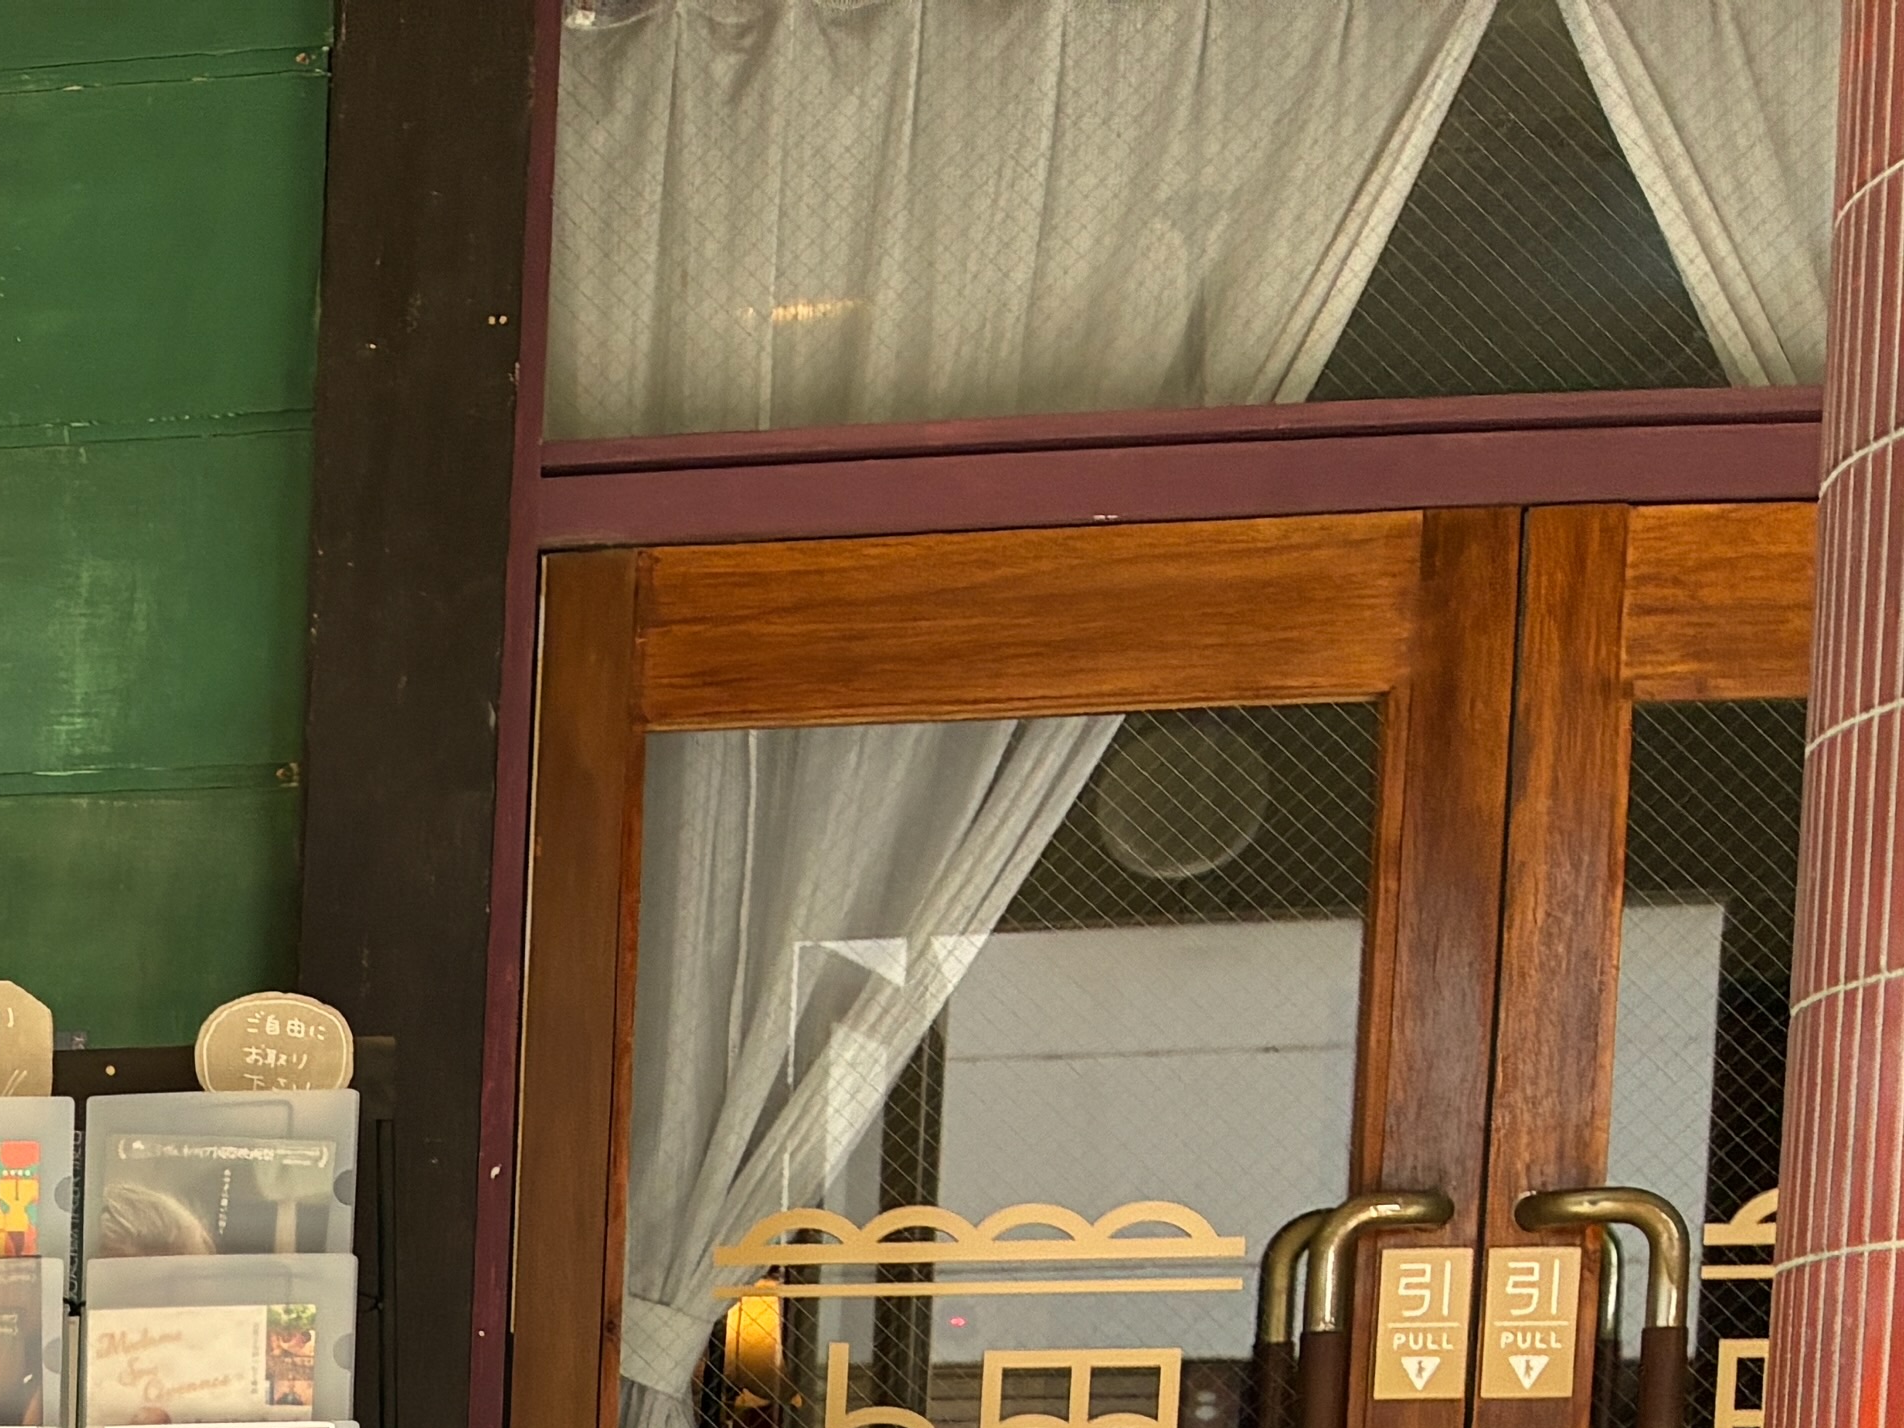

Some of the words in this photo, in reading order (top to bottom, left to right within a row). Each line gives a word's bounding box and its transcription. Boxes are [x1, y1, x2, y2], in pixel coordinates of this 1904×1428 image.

[245, 1011, 328, 1040] ご自由に
[243, 1044, 308, 1070] お取り
[1397, 1259, 1452, 1317] 引
[1505, 1258, 1560, 1317] 引
[1392, 1331, 1455, 1351] PULL
[1499, 1330, 1563, 1350] PULL
